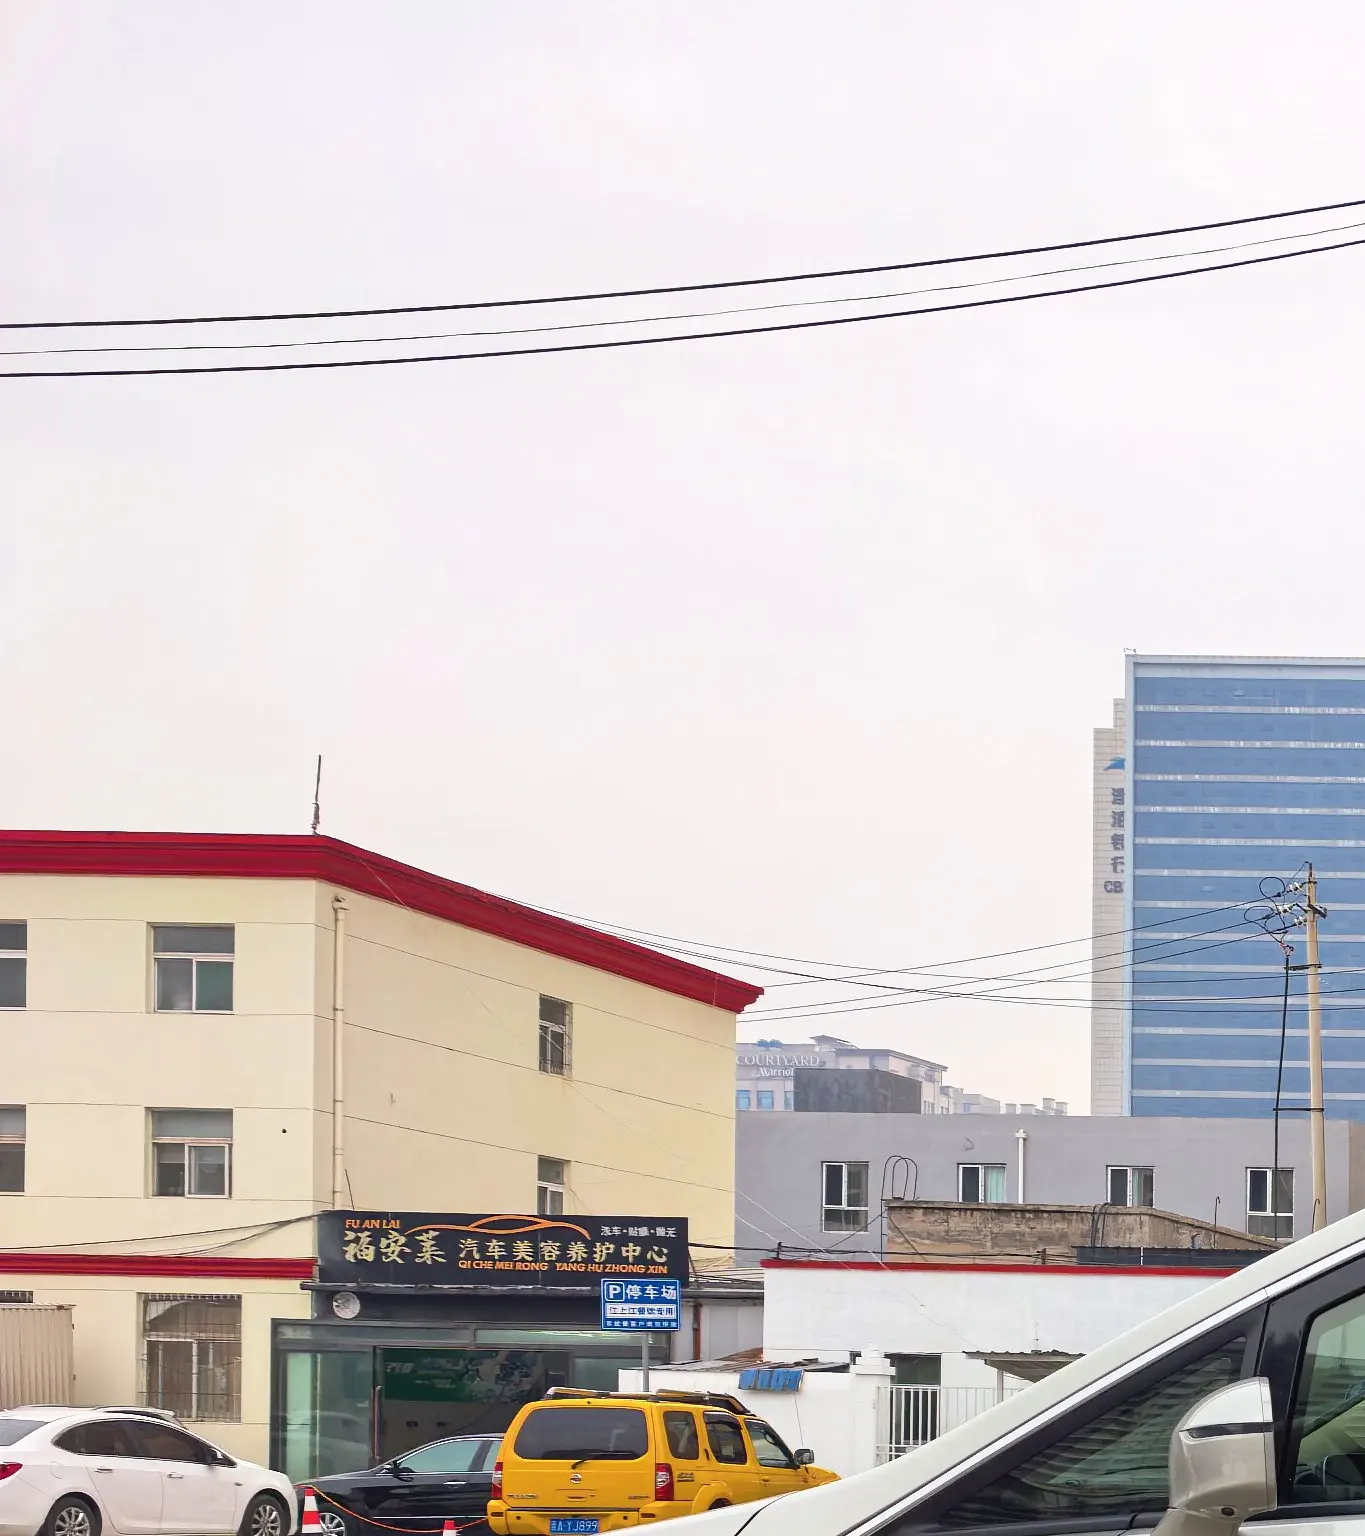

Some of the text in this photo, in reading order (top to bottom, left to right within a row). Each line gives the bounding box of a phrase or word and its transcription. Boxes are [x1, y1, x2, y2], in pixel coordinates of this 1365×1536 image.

[736, 1055, 820, 1067] COURTYARD
[345, 1219, 401, 1229] FU AN LAI
[458, 1238, 669, 1263] 汽车美容养护中心
[458, 1260, 669, 1274] QI CHE MEI RONG YANG HU ZHONG XIN
[626, 1284, 677, 1300] 停车场
